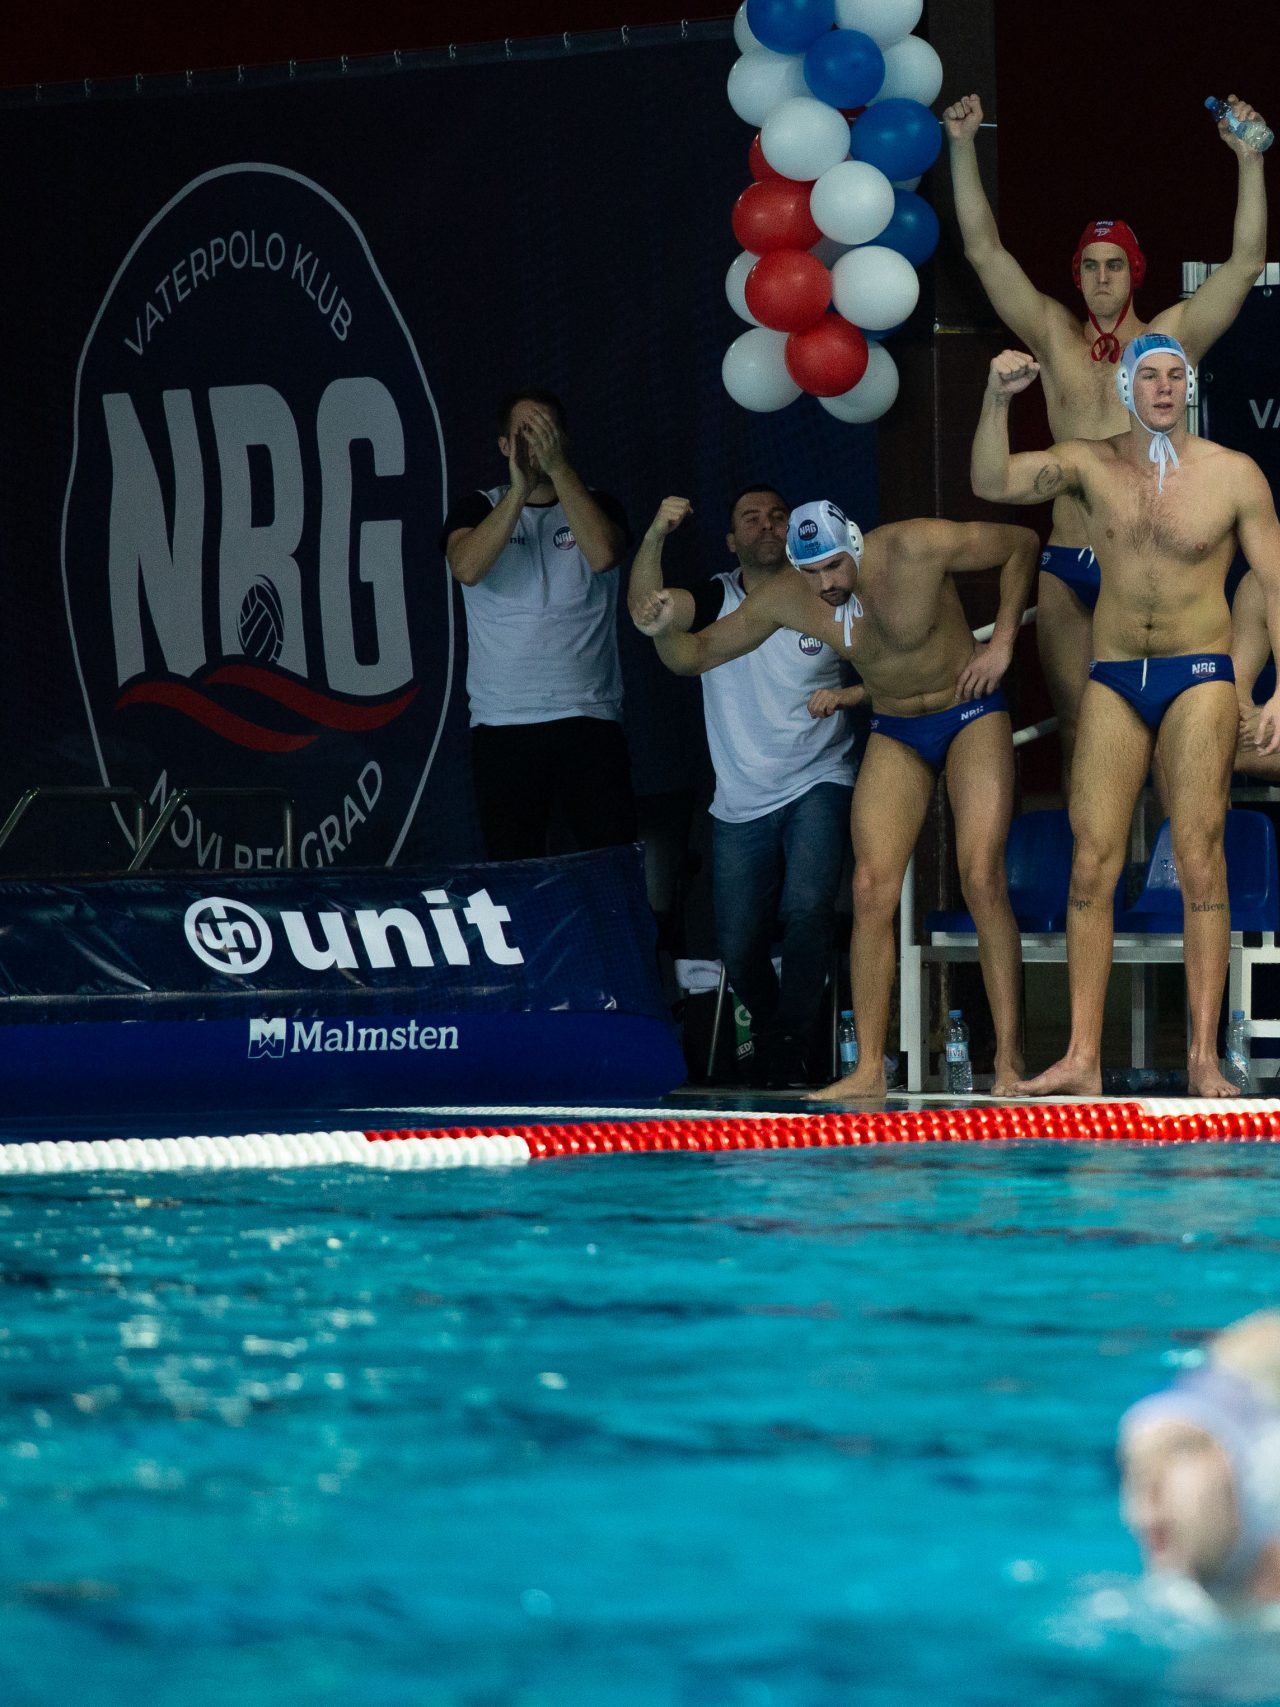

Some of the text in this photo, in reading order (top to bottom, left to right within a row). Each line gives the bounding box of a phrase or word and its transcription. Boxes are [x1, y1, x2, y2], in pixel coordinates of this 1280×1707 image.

[124, 230, 352, 356] VATERPOLO KLUB
[102, 377, 414, 697] NRG
[799, 523, 817, 536] NRG
[1192, 662, 1216, 675] NRG
[234, 760, 383, 870] BEGRAD
[280, 888, 525, 970] unit
[1191, 901, 1225, 913] Believe
[291, 1019, 459, 1053] Malmsten
